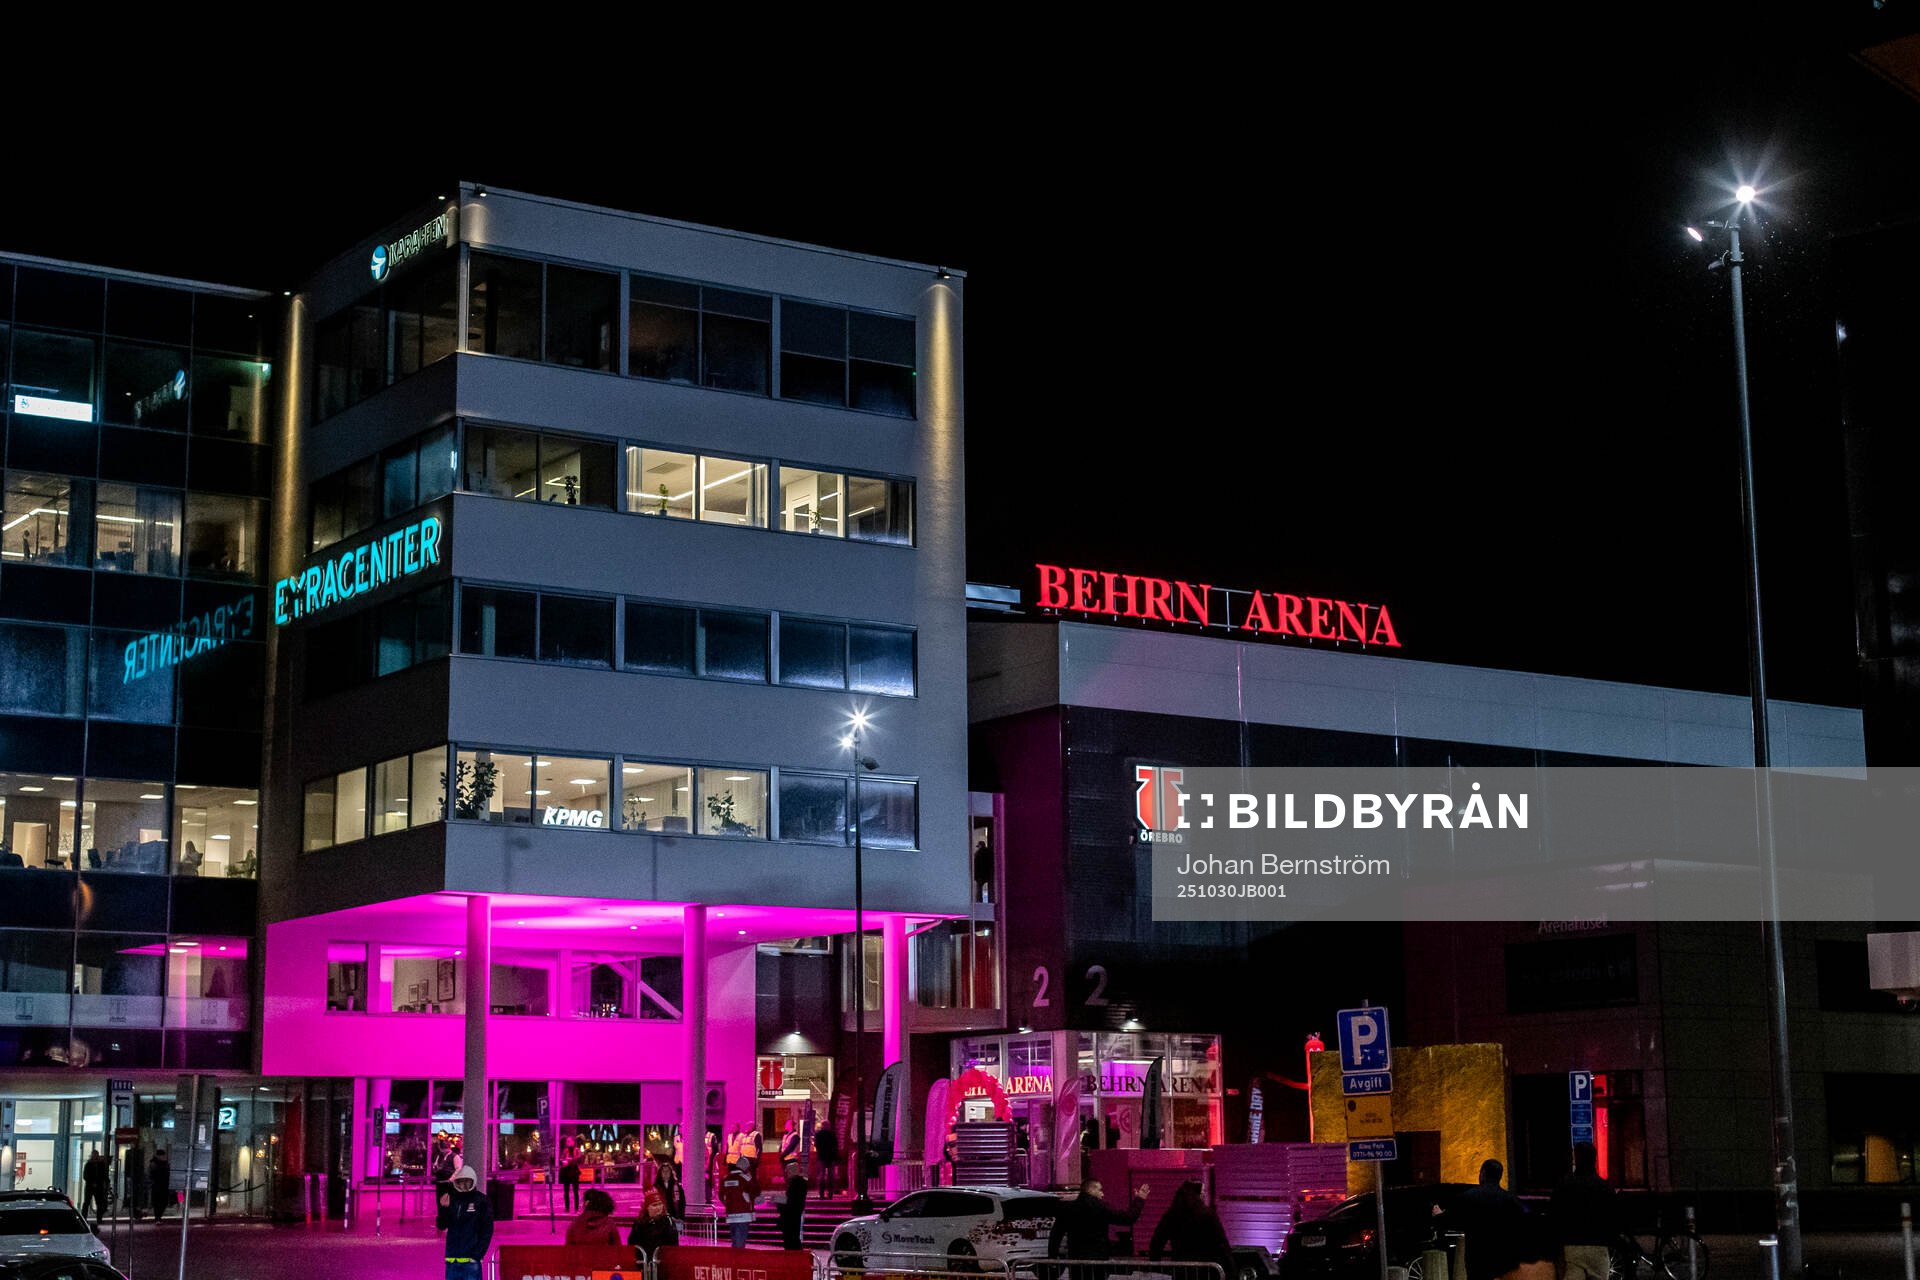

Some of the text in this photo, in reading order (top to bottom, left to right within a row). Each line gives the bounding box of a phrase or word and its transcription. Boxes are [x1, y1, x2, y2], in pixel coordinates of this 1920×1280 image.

[275, 516, 440, 624] EYRACENTER
[1035, 563, 1402, 647] BEHRN ARENA
[542, 805, 604, 828] KPMG
[1140, 828, 1183, 844] ÖREBRO
[1032, 966, 1050, 1007] 2
[1085, 964, 1109, 1006] 2
[1350, 1015, 1378, 1066] P
[1003, 1075, 1052, 1094] ARENA
[1087, 1075, 1146, 1092] BEHRN
[1349, 1077, 1383, 1091] Avgift
[1575, 1074, 1587, 1099] P
